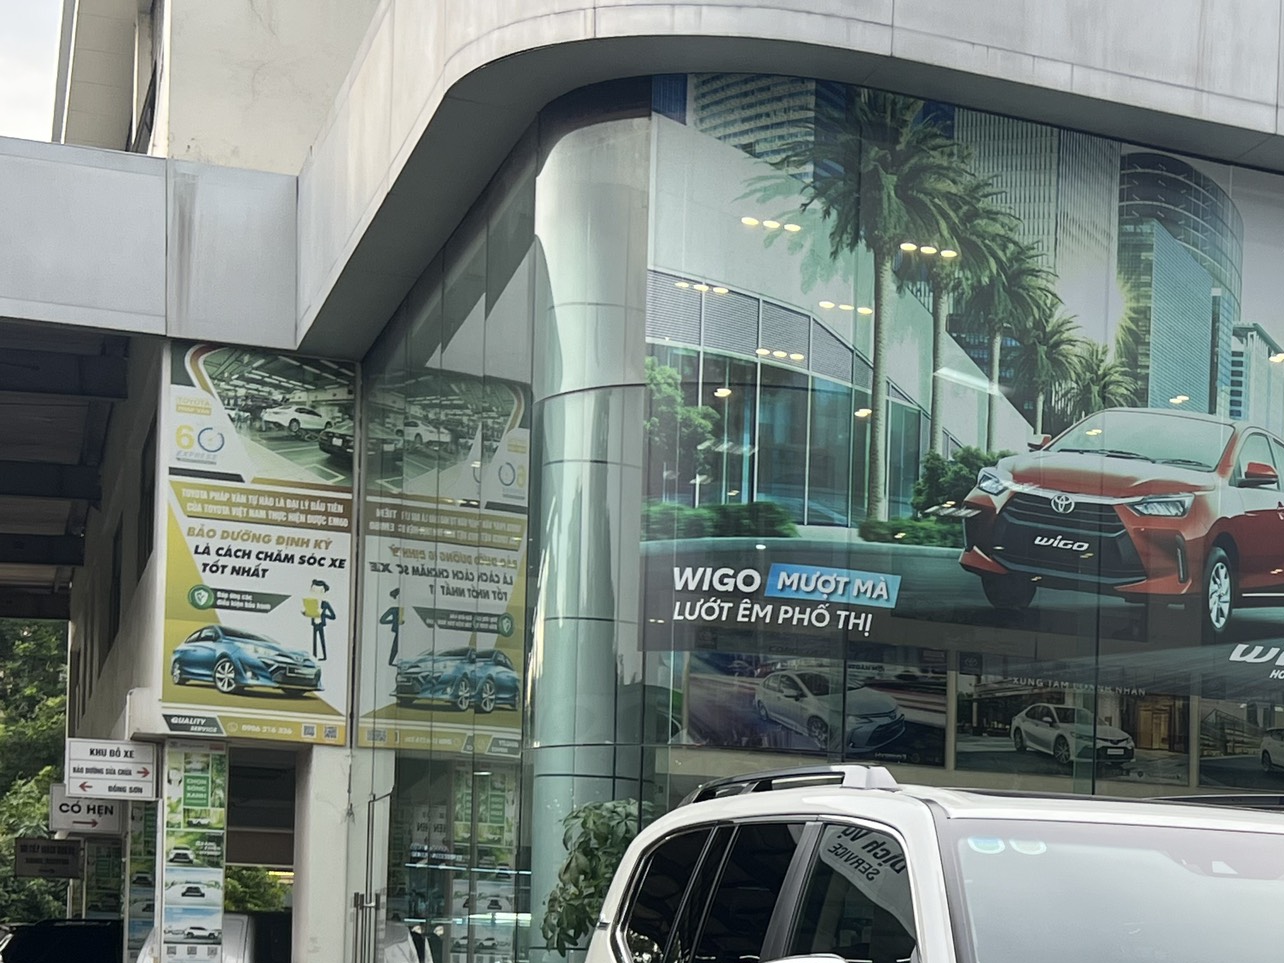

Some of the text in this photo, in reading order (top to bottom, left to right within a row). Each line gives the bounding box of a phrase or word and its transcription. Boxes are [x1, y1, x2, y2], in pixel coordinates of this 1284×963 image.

[187, 525, 216, 539] BẢO
[220, 529, 272, 545] DƯỠNG
[275, 535, 310, 551] ĐỊNH
[215, 545, 252, 561] CÁCH
[255, 548, 295, 565] CHĂM
[298, 552, 326, 567] SÓC
[328, 557, 347, 569] XE
[201, 559, 269, 579] TỐT NHẤT
[673, 566, 889, 600] WIGO MƯỢT MÀ
[673, 597, 873, 637] LƯỚT ÊM PHỐ THỊ
[171, 716, 206, 726] QUALITY
[90, 748, 107, 758] KHU
[123, 750, 135, 758] XE
[59, 800, 114, 818] CÓ HẸN
